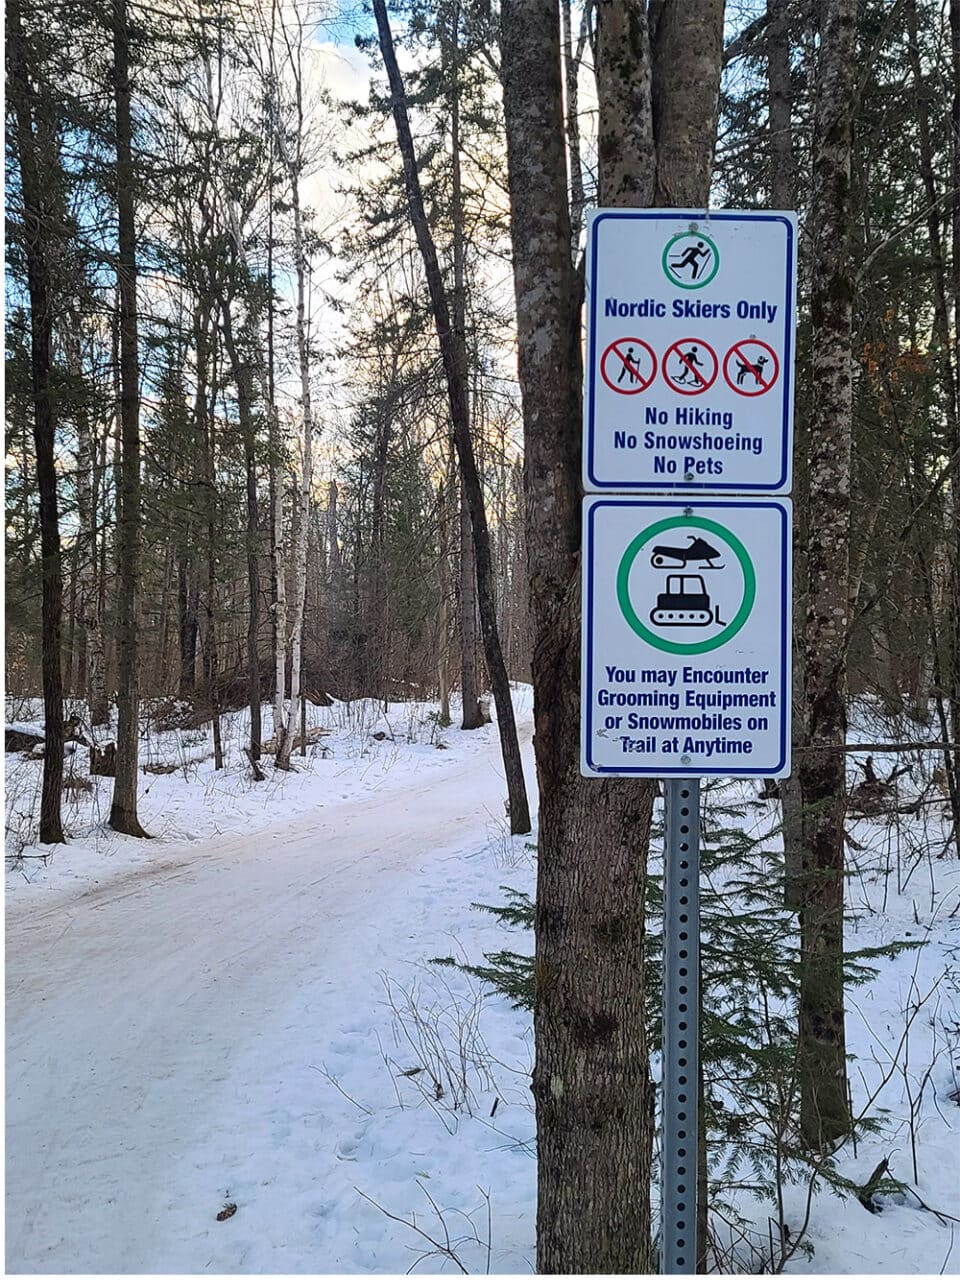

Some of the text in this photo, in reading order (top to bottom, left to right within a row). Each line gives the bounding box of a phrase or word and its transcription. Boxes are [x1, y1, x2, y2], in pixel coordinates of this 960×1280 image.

[605, 299, 777, 323] Nordic Skiers Only
[645, 407, 733, 429] No Hiking
[614, 431, 762, 454] No Snowshoeing
[654, 456, 723, 474] No Pets
[606, 666, 769, 686] You may Encounter
[598, 689, 776, 710] Grooming Equipment
[605, 713, 768, 730] or Snowmobiles on
[621, 736, 753, 756] Trail at Anytime
